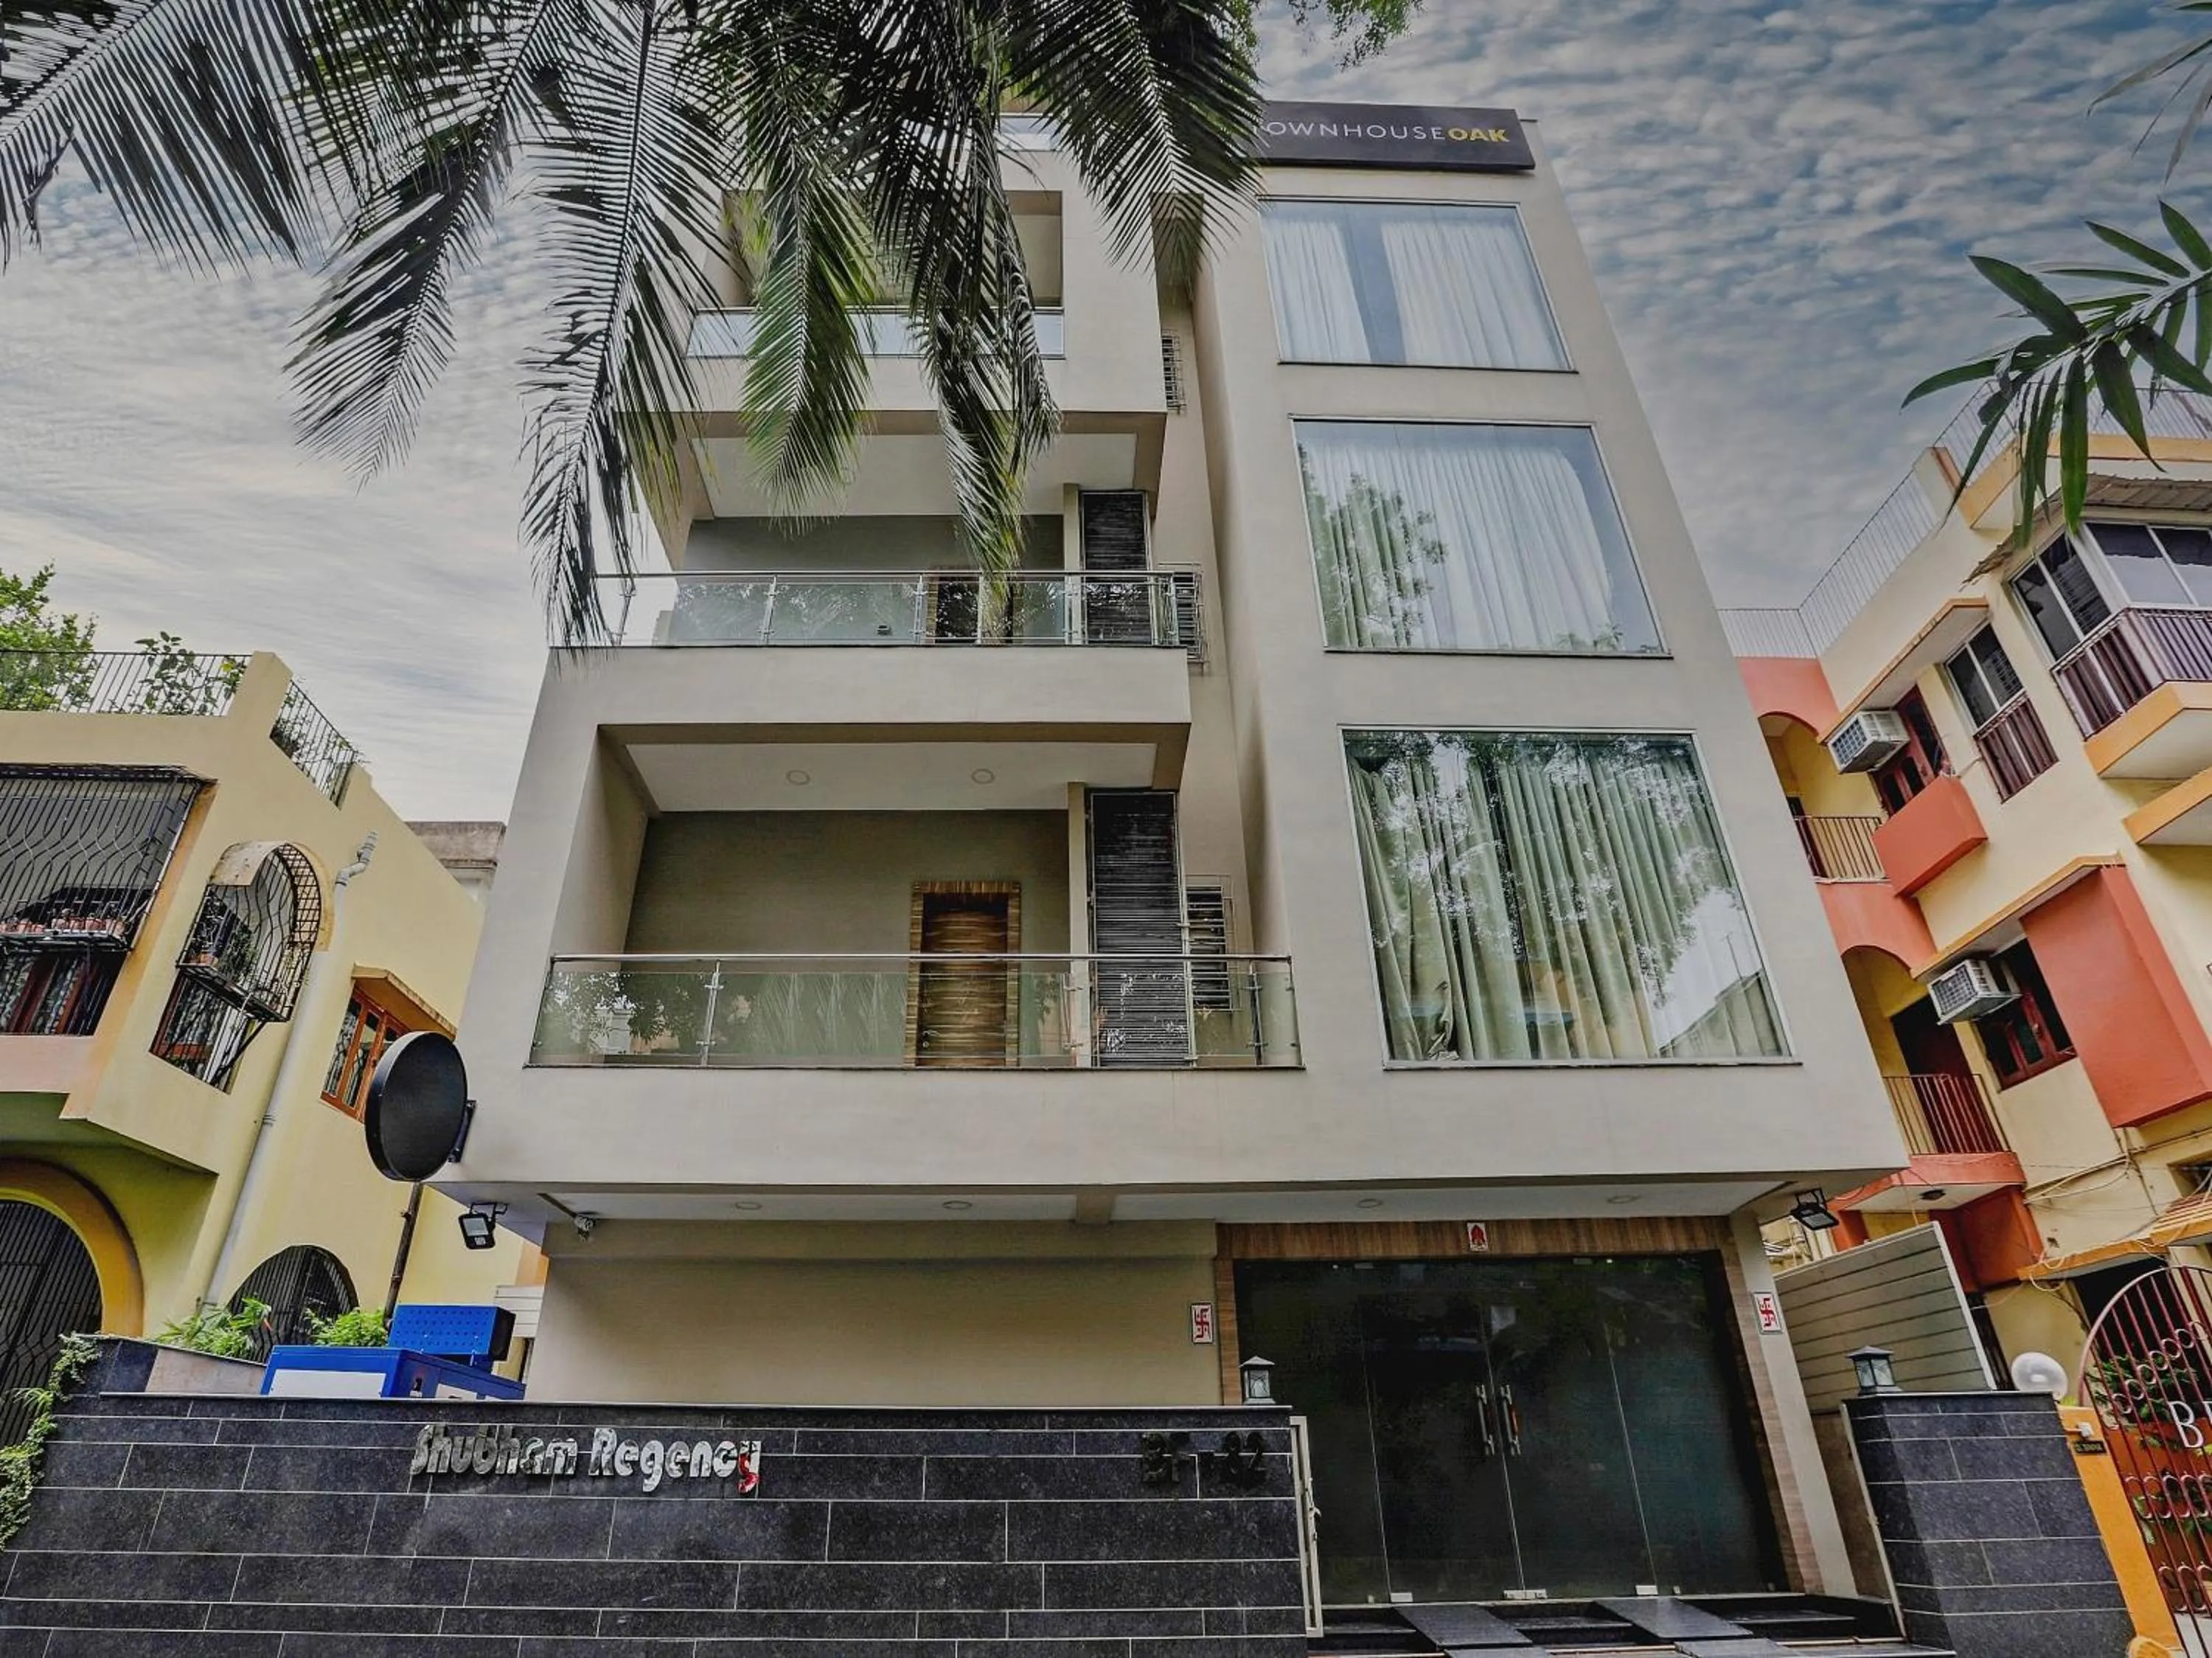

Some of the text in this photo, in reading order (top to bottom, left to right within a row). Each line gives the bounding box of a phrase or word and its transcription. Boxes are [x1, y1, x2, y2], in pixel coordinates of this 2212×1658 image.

[1251, 119, 1510, 142] OWNHOUSEOAK
[410, 1425, 762, 1494] Shubham Regency
